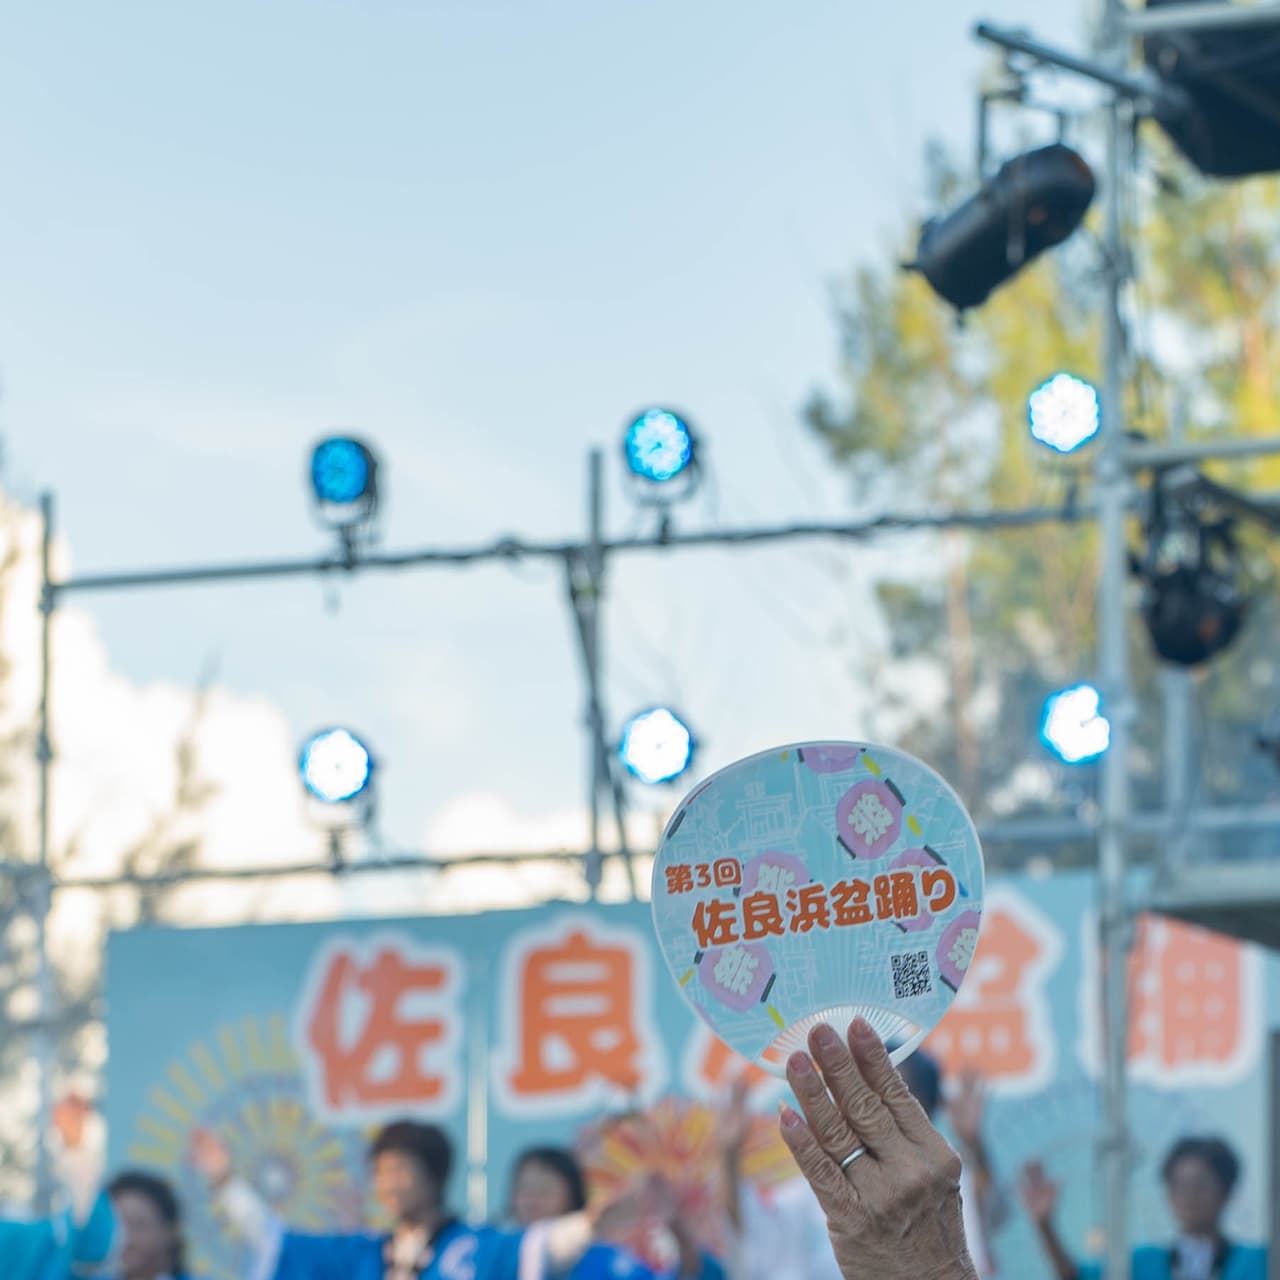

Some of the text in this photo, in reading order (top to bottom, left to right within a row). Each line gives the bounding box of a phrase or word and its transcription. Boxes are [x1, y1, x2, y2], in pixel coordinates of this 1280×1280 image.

[664, 858, 742, 895] 第3回
[691, 868, 957, 948] 佐良浜盆踊り
